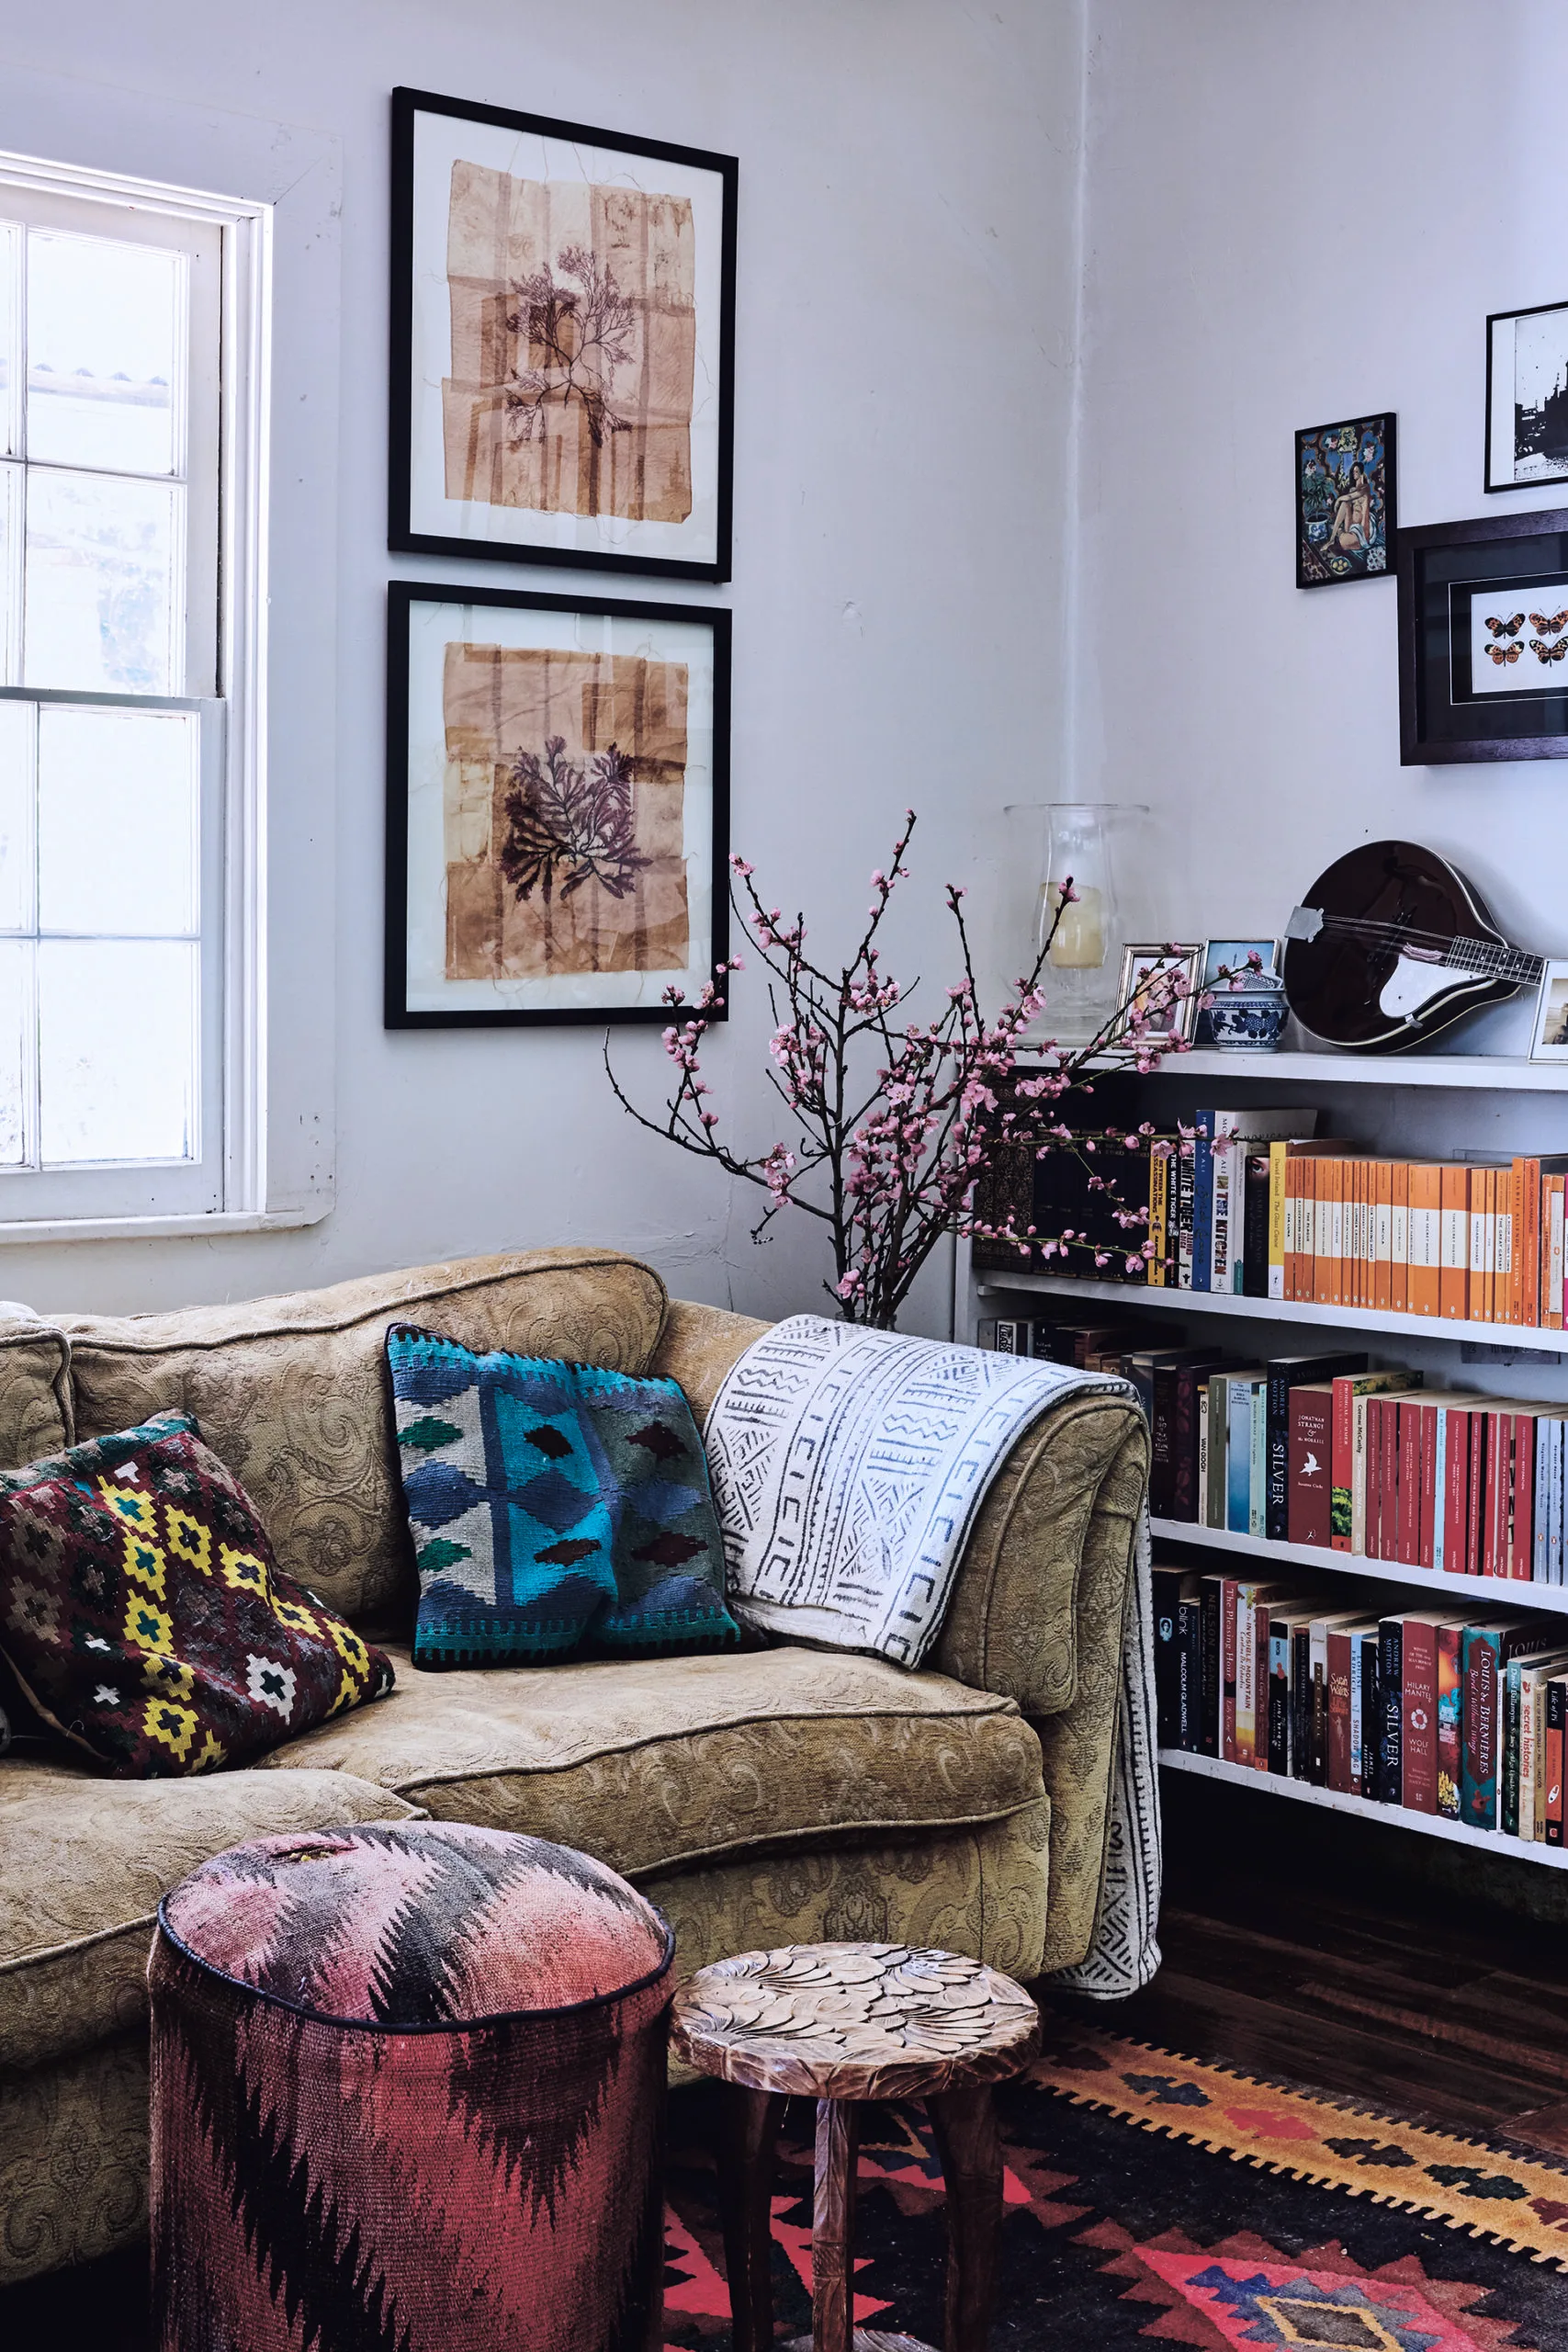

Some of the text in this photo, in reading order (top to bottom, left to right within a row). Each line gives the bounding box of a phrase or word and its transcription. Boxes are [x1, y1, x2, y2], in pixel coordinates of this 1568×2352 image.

[1217, 1176, 1228, 1189] IN
[1217, 1192, 1228, 1216] THE
[1215, 1220, 1228, 1274] KITCHEN
[1272, 1443, 1284, 1505] SILVER
[1179, 1607, 1188, 1634] blink
[1224, 1611, 1233, 1649] Pleasing
[1407, 1681, 1430, 1691] HILARY
[1480, 1650, 1491, 1691] LOUIS
[1405, 1689, 1432, 1700] MANTEL
[1509, 1689, 1517, 1724] Ballantyne
[1387, 1704, 1398, 1767] SILVER
[1409, 1739, 1429, 1749] WOLF
[1410, 1747, 1427, 1756] HALL
[1523, 1737, 1534, 1778] histories
